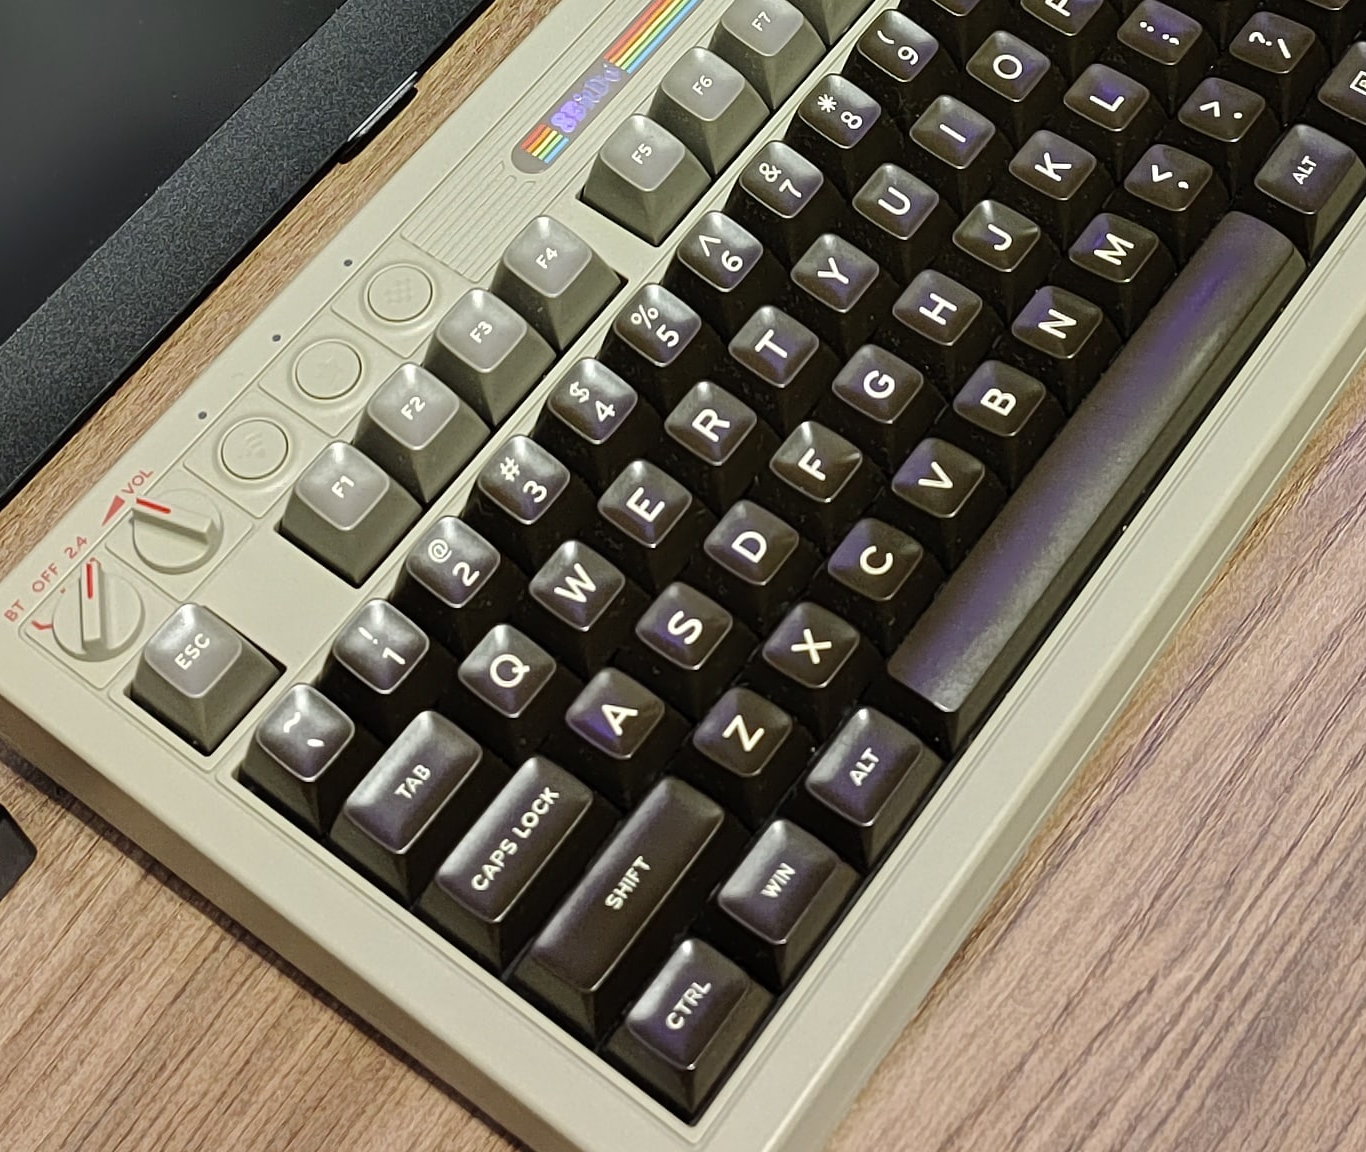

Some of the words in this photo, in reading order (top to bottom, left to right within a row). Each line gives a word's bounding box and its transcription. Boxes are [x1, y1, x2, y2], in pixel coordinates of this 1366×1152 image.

[752, 12, 770, 31] F7
[898, 47, 918, 65] 9
[993, 55, 1022, 79] O
[693, 76, 712, 95] F6
[1090, 96, 1124, 111] L
[841, 112, 862, 129] 8
[940, 124, 966, 142] I
[632, 144, 651, 164] F5
[1035, 153, 1071, 181] K
[1293, 156, 1316, 184] ALT
[779, 179, 801, 197] 7
[878, 187, 910, 215] U
[988, 224, 1012, 250] J
[1094, 234, 1134, 265] M
[536, 248, 557, 269] F4
[722, 251, 743, 271] 6
[818, 258, 849, 284] Y
[919, 293, 957, 325] H
[470, 321, 492, 343] F3
[656, 325, 679, 347] 5
[1038, 309, 1076, 338] N
[755, 330, 787, 358] T
[864, 371, 895, 398] G
[401, 397, 425, 420] F2
[596, 401, 615, 421] 4
[980, 388, 1017, 416] B
[692, 409, 730, 442] R
[798, 449, 825, 480] F
[918, 462, 953, 488] V
[121, 468, 154, 496] VOL
[332, 476, 354, 498] F1
[523, 481, 547, 502] 3
[626, 488, 665, 522] E
[732, 532, 766, 563] D
[860, 546, 893, 574] C
[453, 562, 479, 586] 2
[554, 564, 596, 602] W
[3, 599, 25, 622] BT
[31, 562, 59, 593] OFF
[668, 611, 702, 644] S
[175, 634, 210, 669] ESC
[383, 648, 405, 664] 1
[791, 629, 831, 664] X
[490, 655, 530, 687] Q
[602, 705, 638, 735] A
[723, 715, 764, 751] Z
[850, 748, 878, 785] ALT
[395, 765, 430, 798] TAB
[472, 839, 517, 890] CAPS
[512, 788, 559, 838] LOCK
[606, 856, 649, 909] SHIFT
[762, 863, 795, 897] WIN
[666, 983, 711, 1029] CTRL
